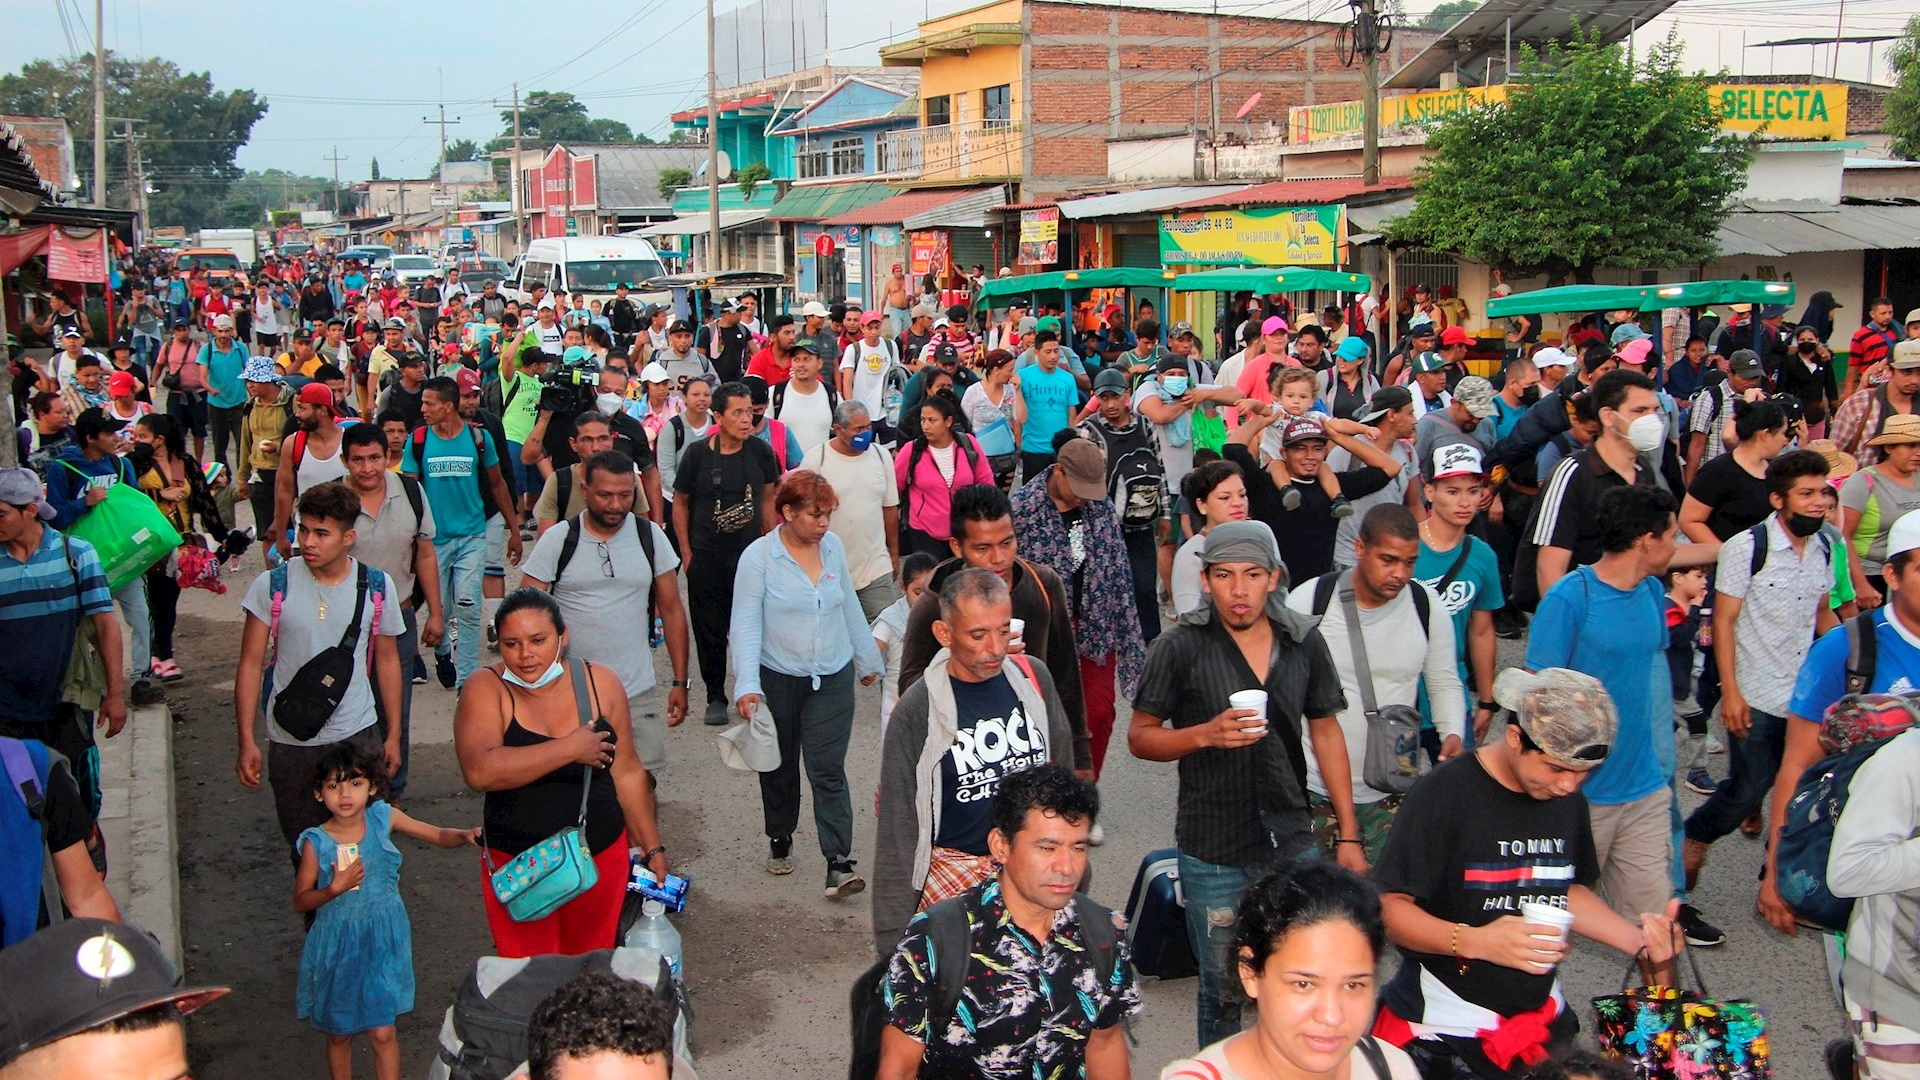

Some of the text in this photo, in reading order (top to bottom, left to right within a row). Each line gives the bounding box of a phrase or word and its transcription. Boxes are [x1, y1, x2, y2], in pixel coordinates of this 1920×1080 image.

[1721, 89, 1829, 122] SELECTA
[1311, 104, 1364, 134] TORTILLERIA
[1397, 99, 1412, 124] LA
[1162, 219, 1185, 231] PEDIDOS
[1214, 218, 1222, 229] 44
[1304, 235, 1319, 245] Selecta
[916, 249, 930, 260] LUCY
[428, 461, 473, 473] GUESS
[958, 768, 997, 786] The
[1497, 838, 1565, 857] TOMMY
